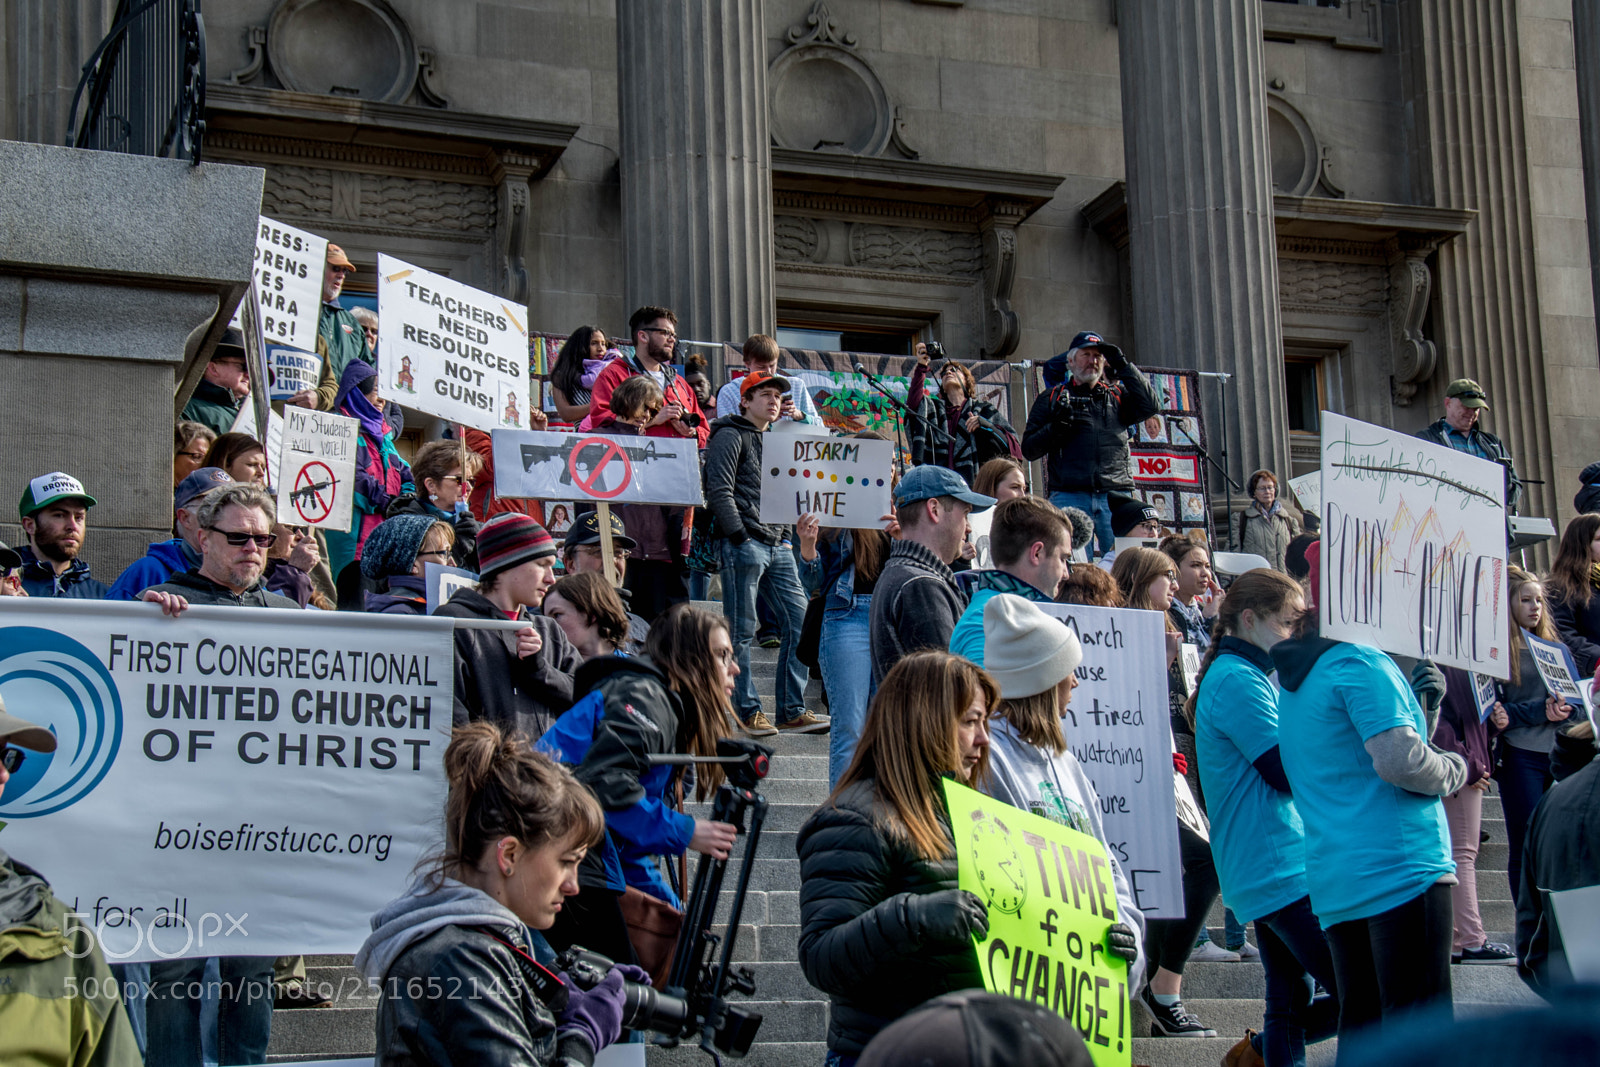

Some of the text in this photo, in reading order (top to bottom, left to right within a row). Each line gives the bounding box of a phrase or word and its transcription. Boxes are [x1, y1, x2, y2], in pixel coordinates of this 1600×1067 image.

[261, 290, 298, 317] NRA
[405, 280, 507, 332] TEACHERS
[438, 313, 489, 346] NEED
[276, 354, 315, 372] MARCH
[403, 322, 520, 378] RESOURCES
[276, 366, 318, 385] FOR OUR
[277, 378, 309, 391] LIVES
[444, 359, 485, 387] NOT
[434, 378, 494, 413] GUNS!
[794, 440, 859, 463] DISARM
[1137, 457, 1172, 475] NO!
[796, 489, 846, 517] HATE
[108, 633, 438, 687] FIRST CONGREGATIONAL
[146, 682, 432, 730] UNITED CHURCH
[1086, 690, 1144, 727] tired
[142, 728, 431, 771] OF CHRIST
[1073, 739, 1143, 784] watching
[154, 821, 392, 862] boisefirstucc.org
[1022, 829, 1115, 921] TIME
[154, 897, 188, 928] all
[1039, 908, 1104, 967] for
[988, 938, 1125, 1054] CHANGE!
